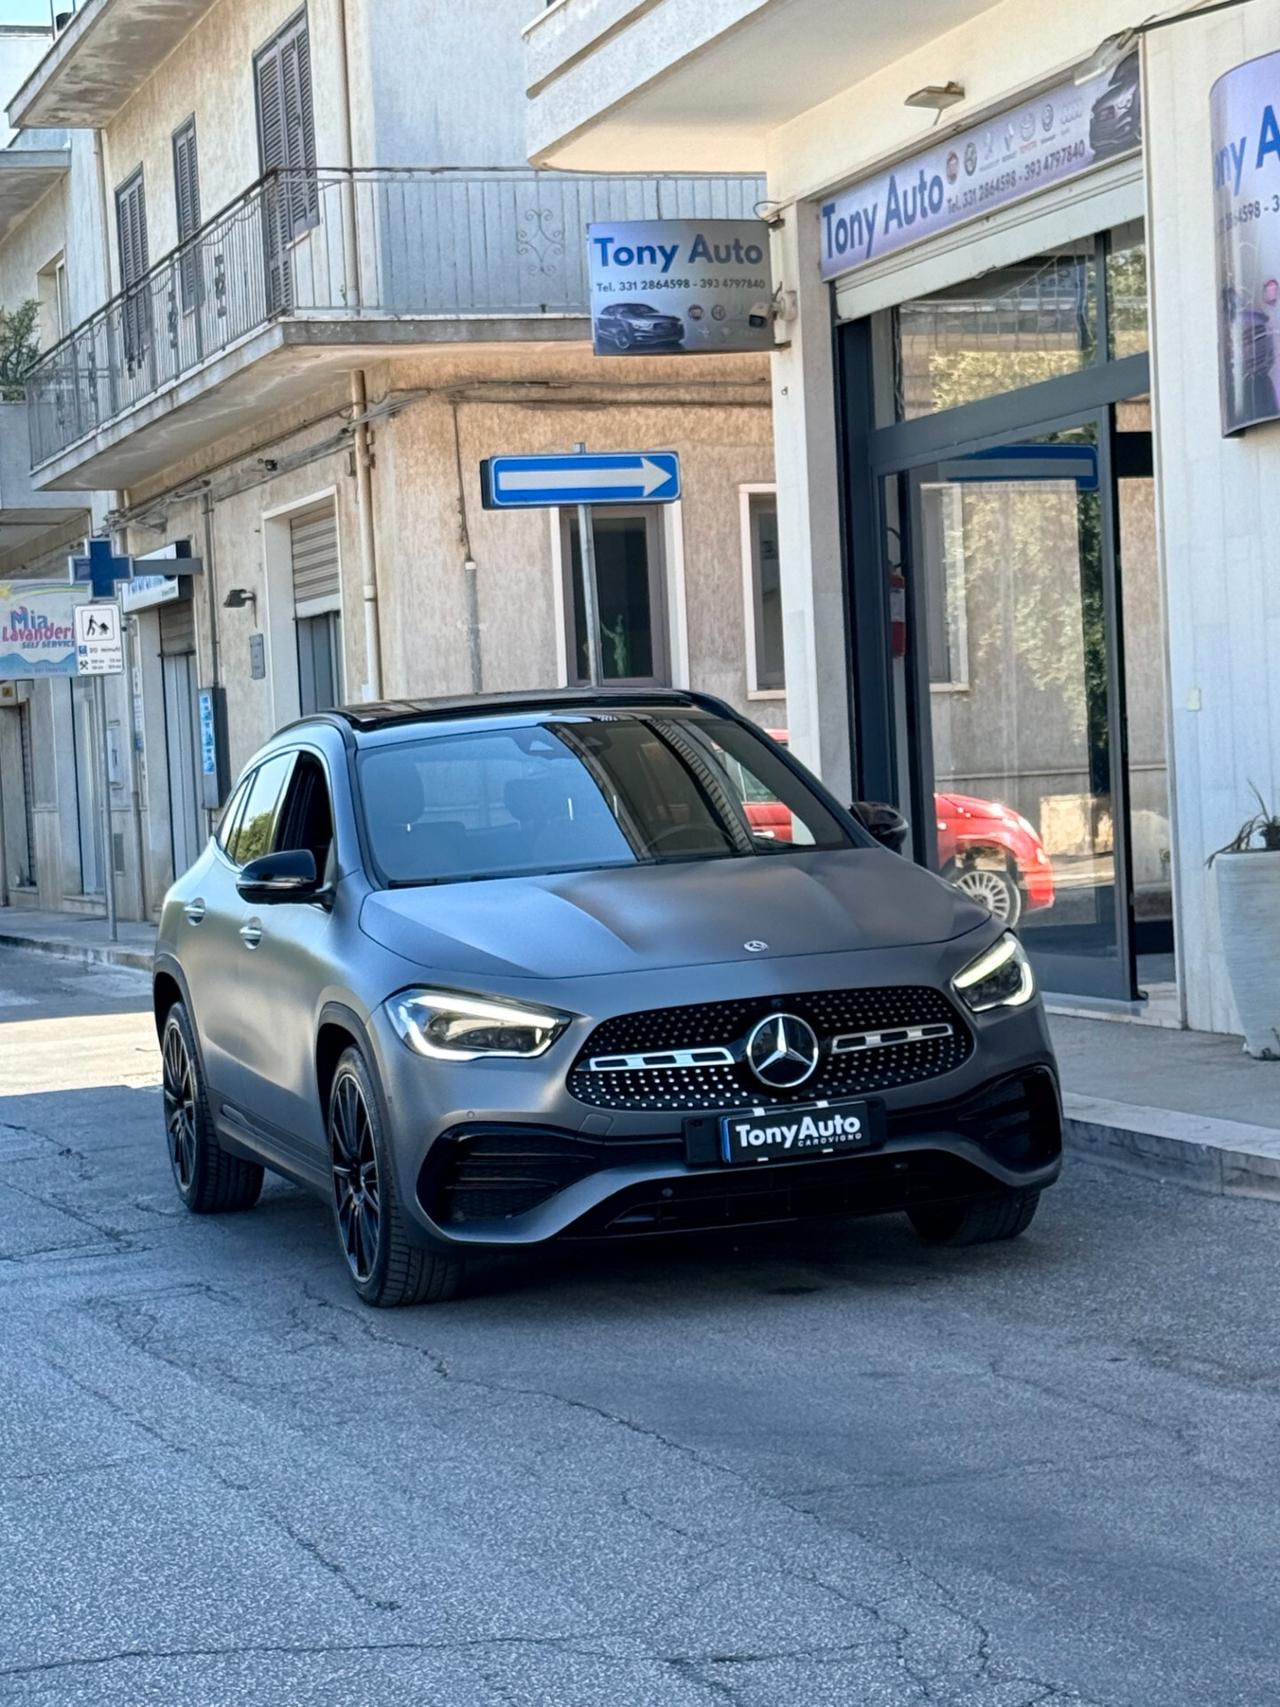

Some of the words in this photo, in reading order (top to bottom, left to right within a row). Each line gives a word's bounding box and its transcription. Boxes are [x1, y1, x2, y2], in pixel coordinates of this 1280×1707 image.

[963, 188, 977, 208] 331
[1025, 157, 1041, 182] 393
[822, 202, 878, 259] Tony
[884, 169, 944, 235] Auto
[593, 237, 680, 273] Tony
[687, 233, 763, 265] Auto
[596, 282, 616, 293] Tel.
[619, 281, 638, 292] 331
[641, 278, 690, 291] 2864598
[700, 278, 720, 289] 393
[722, 278, 766, 289] 4797840
[10, 606, 48, 631] Mia
[735, 1114, 861, 1149] TonyAuto
[798, 1132, 862, 1147] CAROVIGNO
